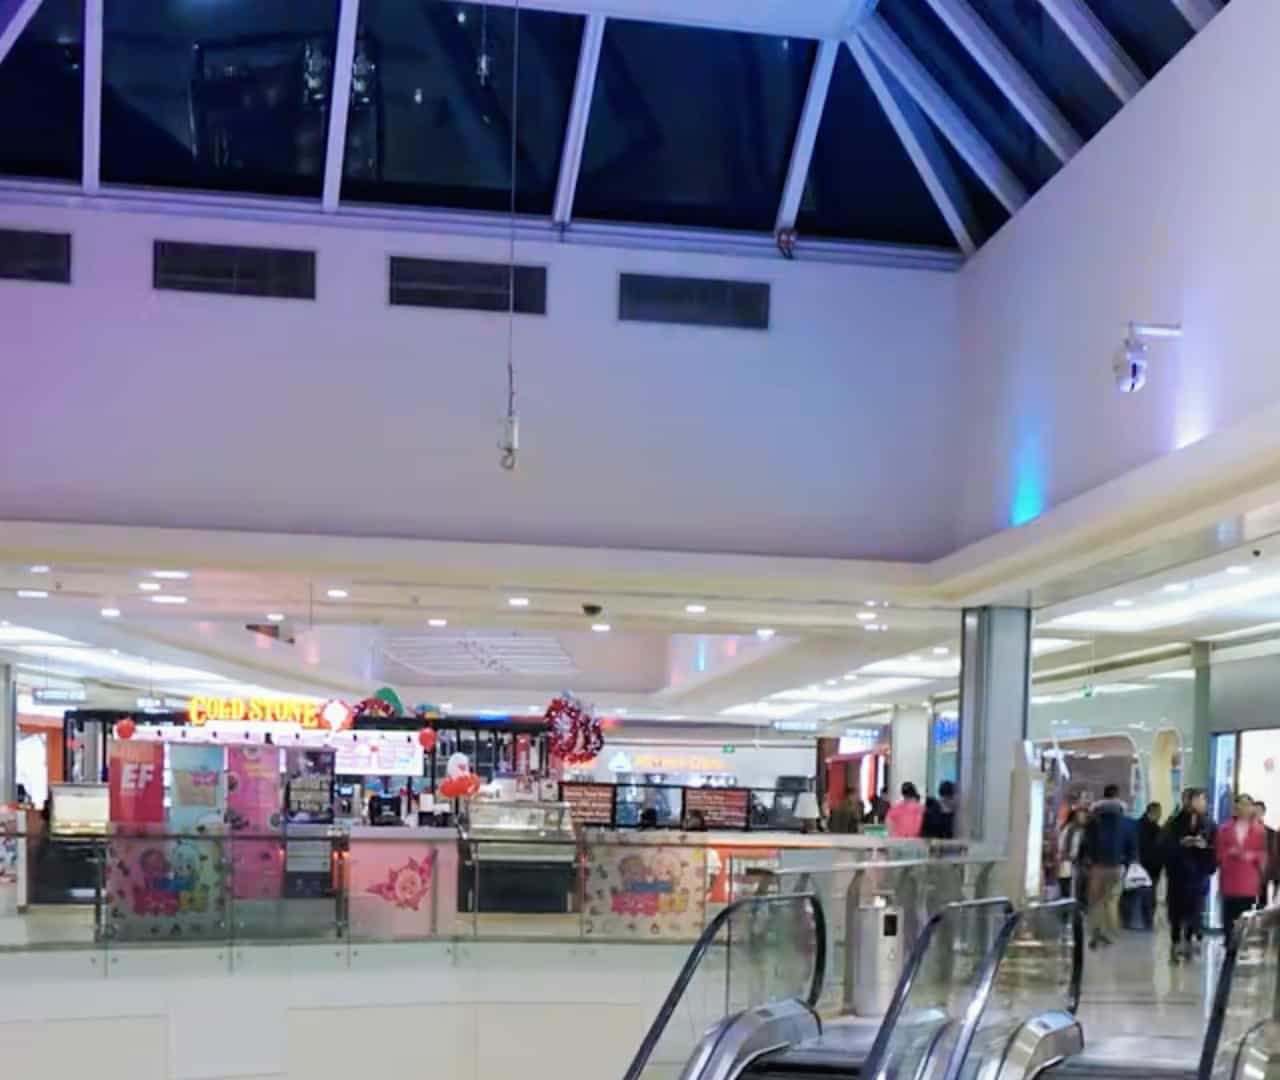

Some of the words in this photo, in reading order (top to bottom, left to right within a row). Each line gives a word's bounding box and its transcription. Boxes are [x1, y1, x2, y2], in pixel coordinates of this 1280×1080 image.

[189, 696, 245, 726] COLD
[250, 697, 320, 729] STONE
[121, 763, 155, 789] EF
